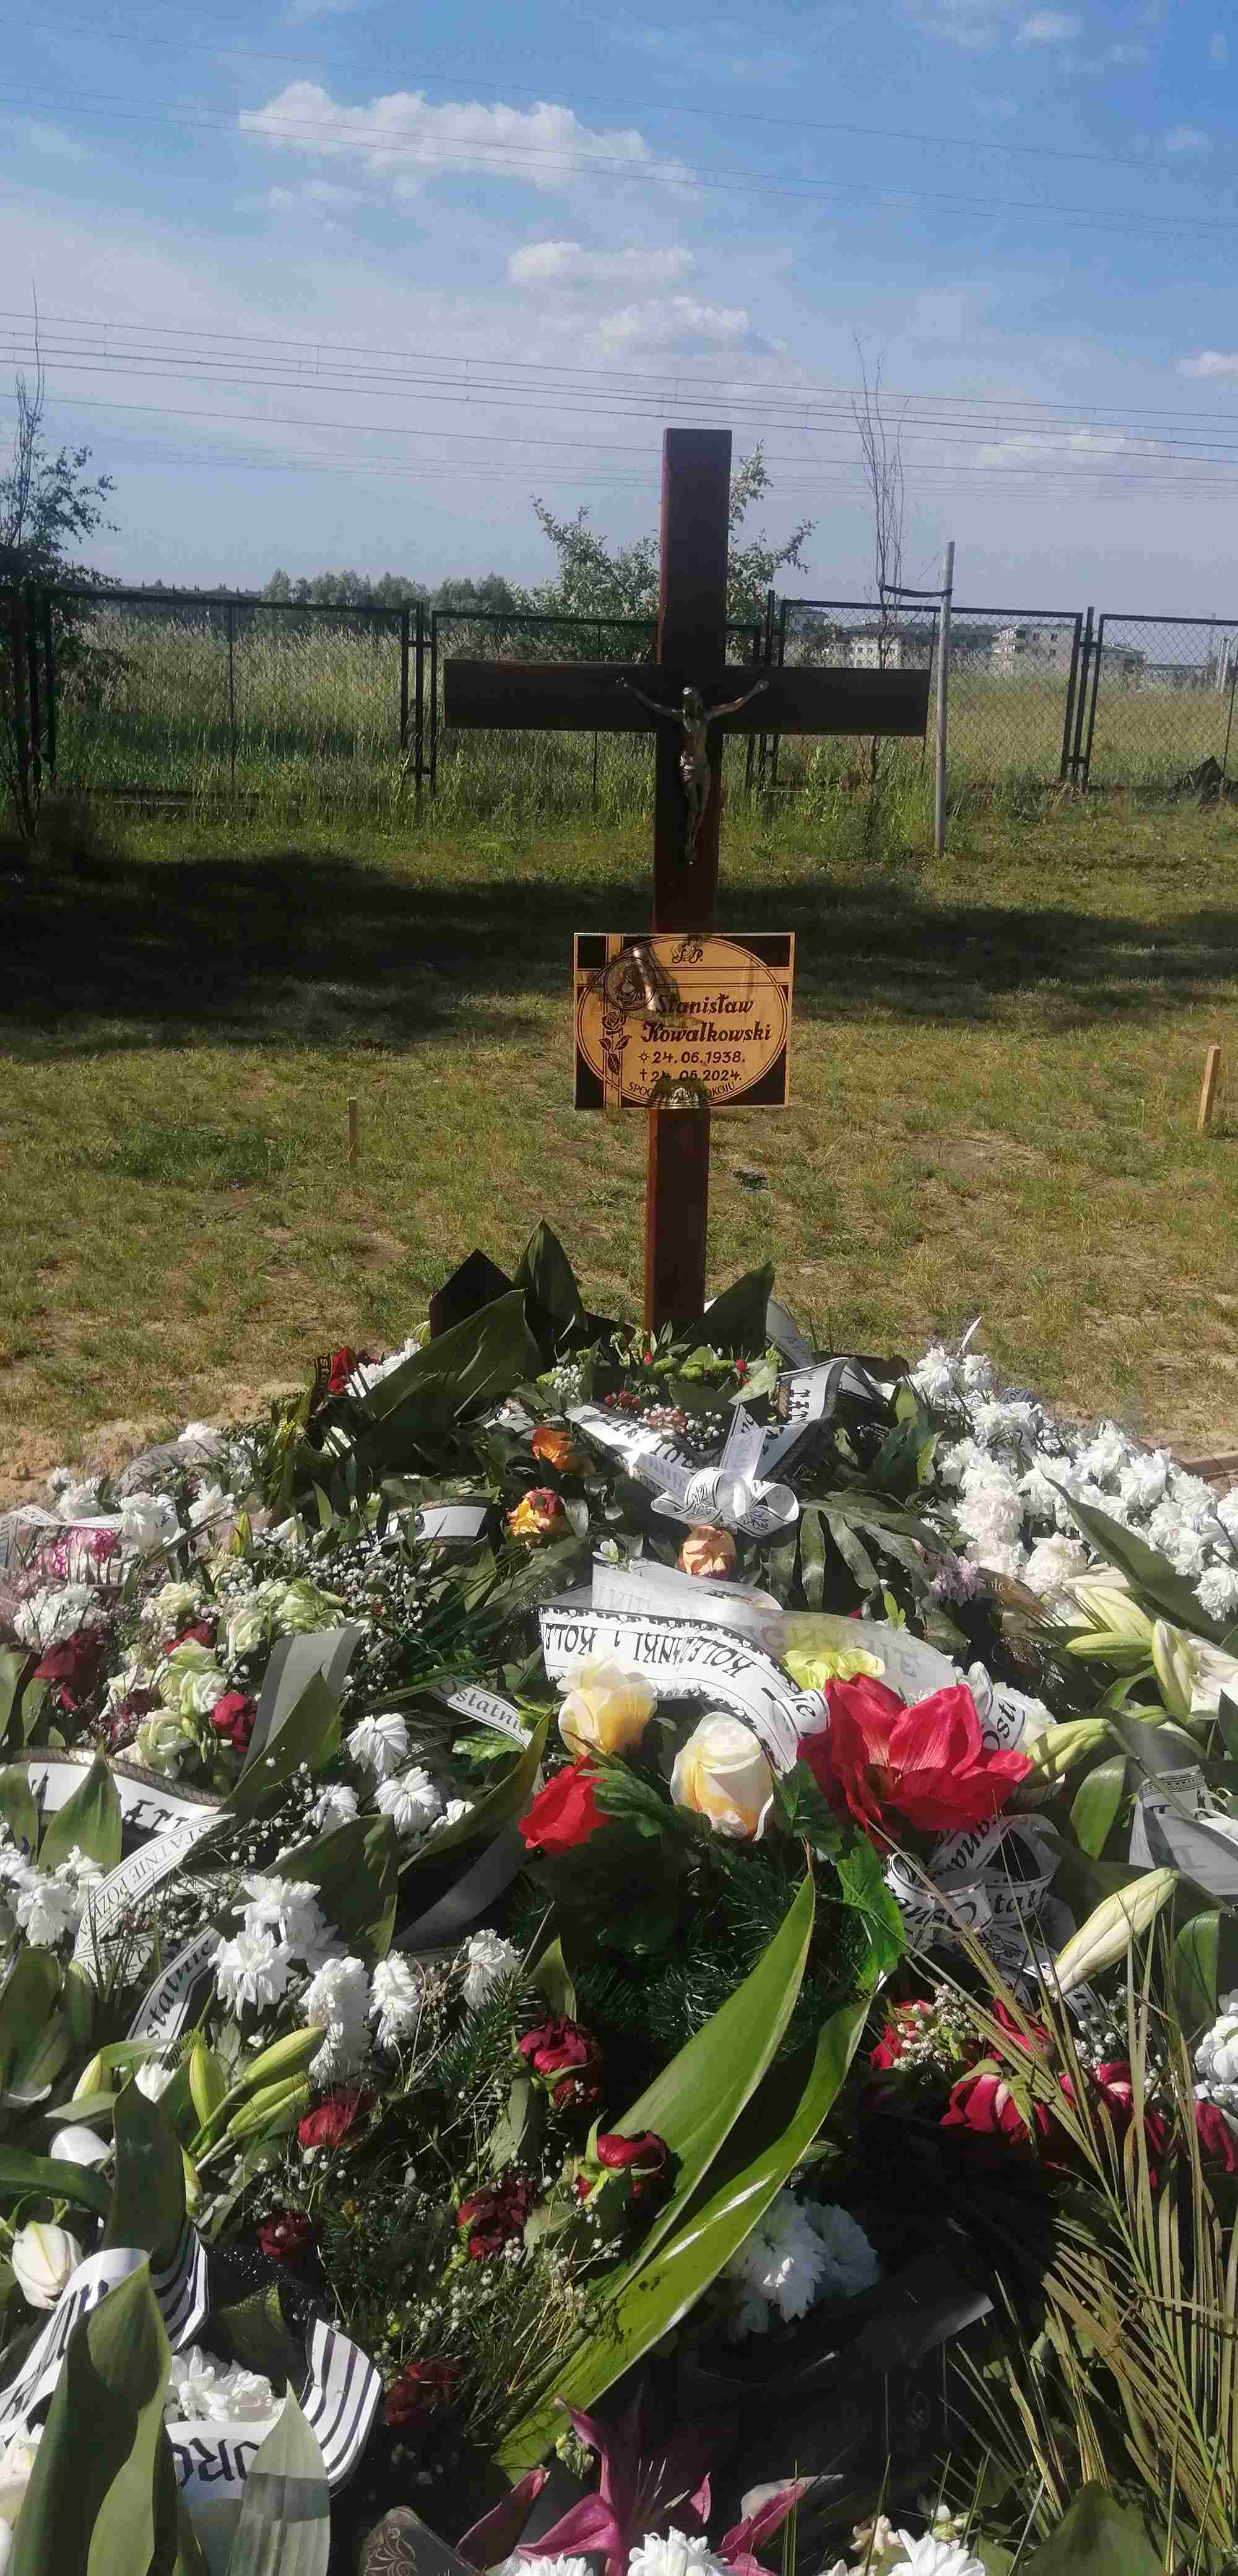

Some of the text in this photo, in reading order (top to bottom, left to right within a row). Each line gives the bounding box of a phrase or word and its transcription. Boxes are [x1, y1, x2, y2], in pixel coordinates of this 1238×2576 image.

[655, 993, 754, 1014] Stanisław
[640, 1021, 771, 1042] Kowalkowski
[146, 1941, 212, 2039] statnie
